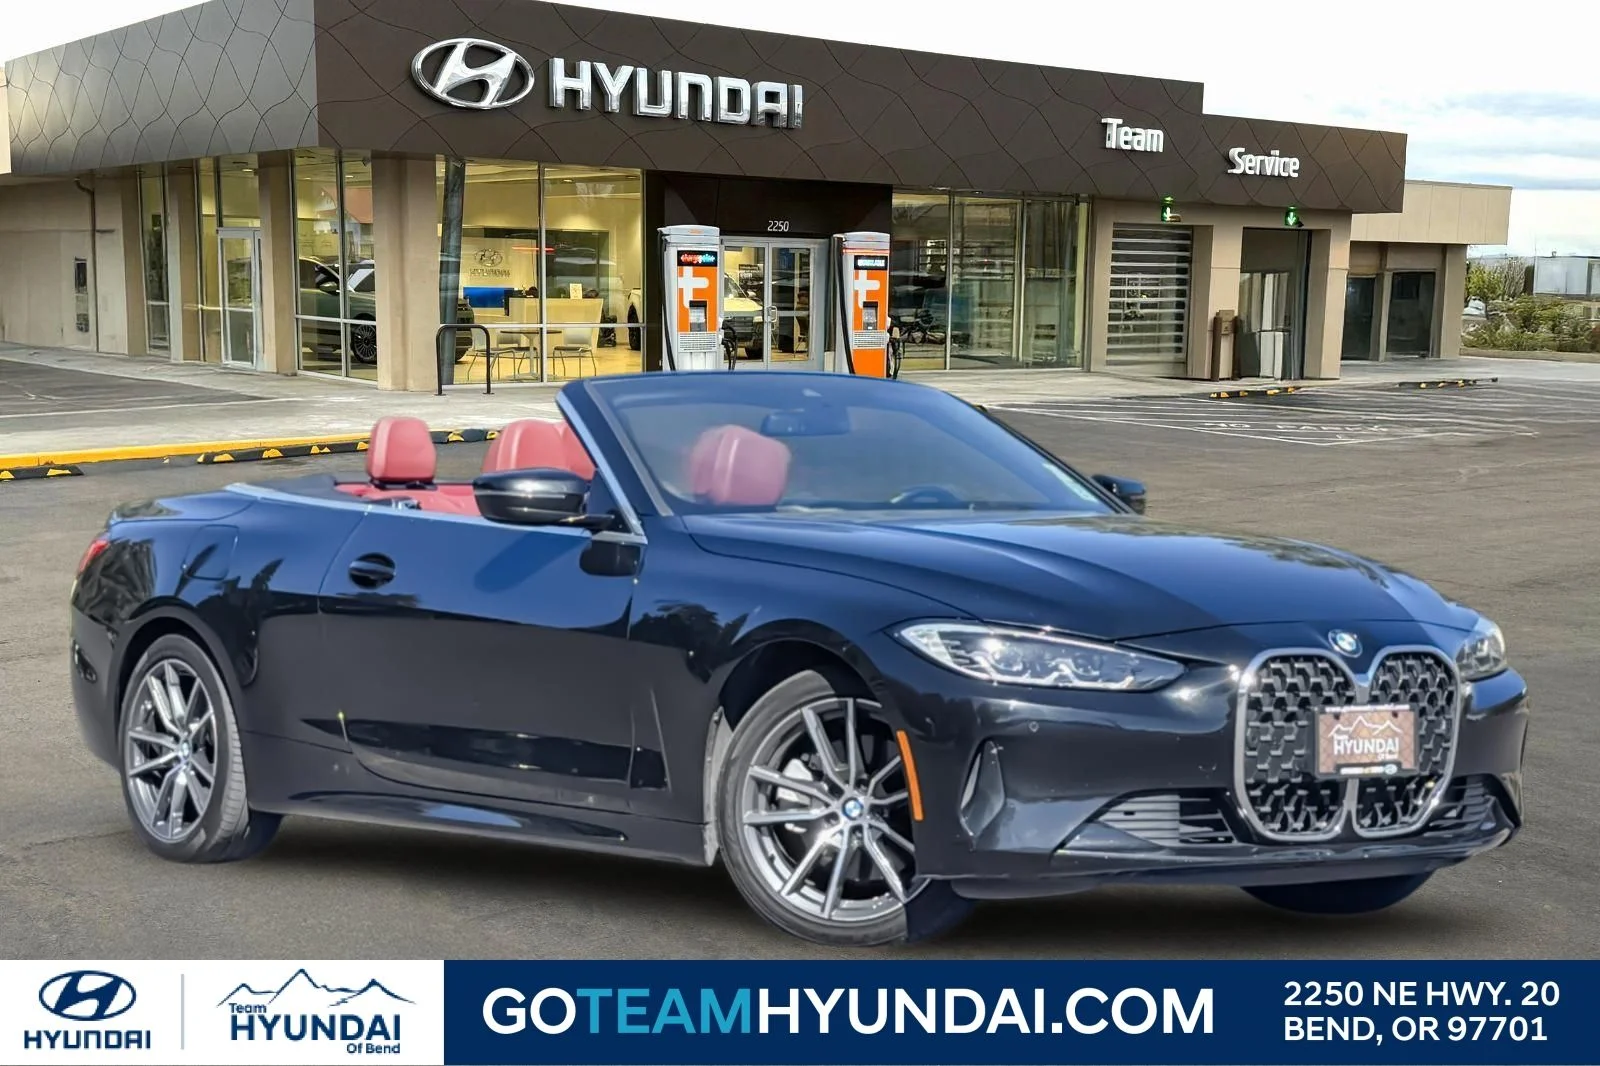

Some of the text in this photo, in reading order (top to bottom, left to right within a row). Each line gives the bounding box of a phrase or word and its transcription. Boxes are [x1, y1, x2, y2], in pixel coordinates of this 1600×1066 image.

[549, 57, 804, 128] HYUNDAI
[1101, 117, 1164, 153] Team
[1227, 147, 1300, 178] Service
[767, 220, 790, 232] 2250
[1333, 737, 1399, 755] HYUNDAI
